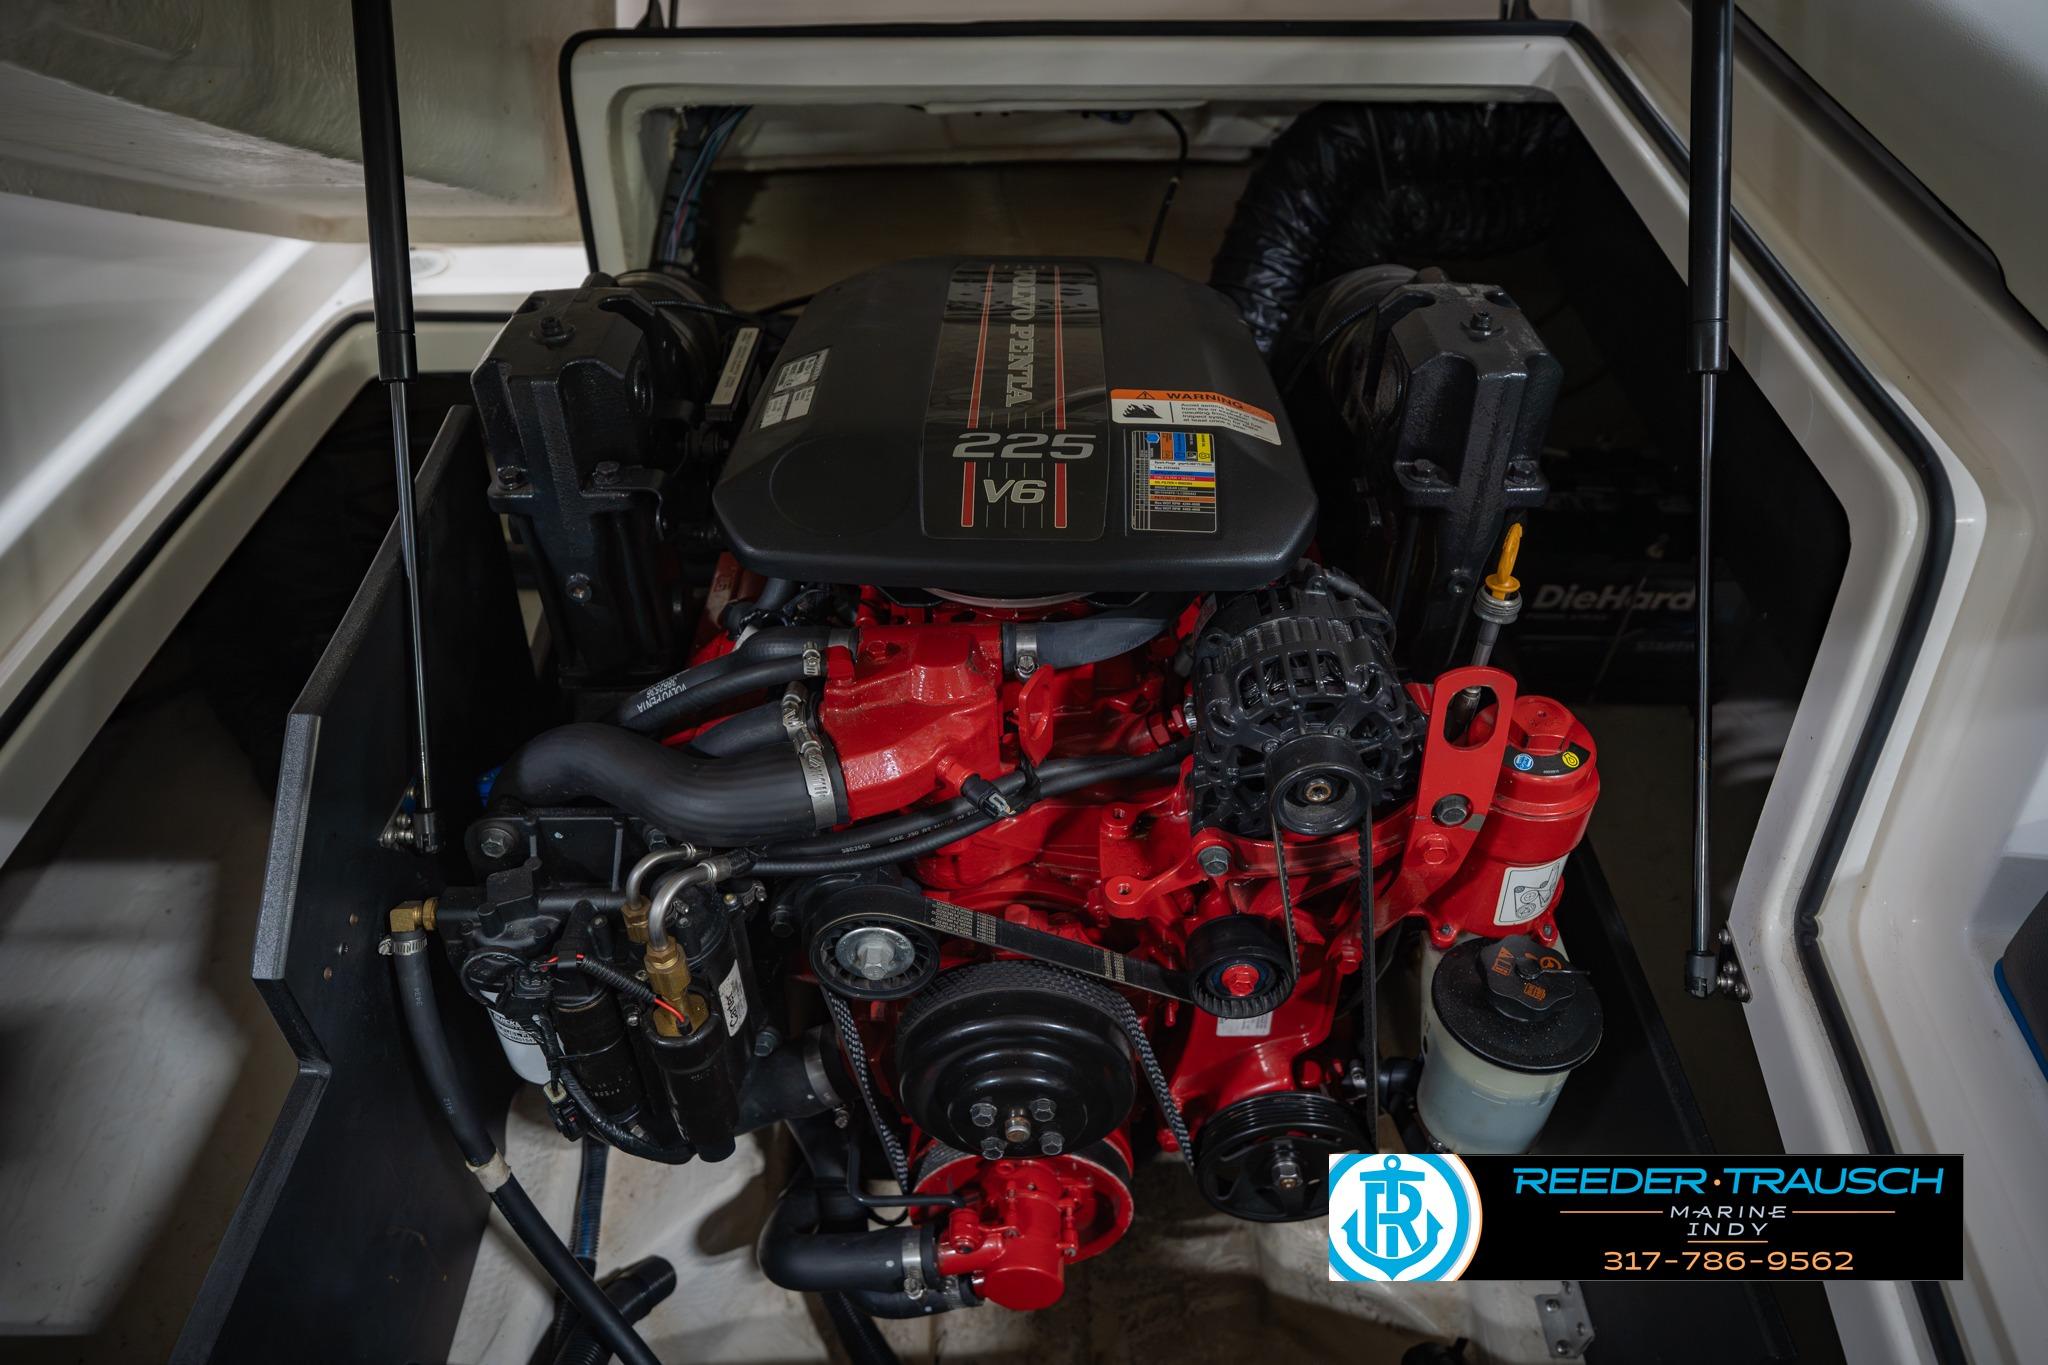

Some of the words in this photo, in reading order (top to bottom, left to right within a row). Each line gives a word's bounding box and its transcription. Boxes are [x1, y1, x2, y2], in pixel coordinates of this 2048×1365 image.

[1010, 269, 1036, 321] VOLVO
[1005, 323, 1035, 408] PENTA
[1166, 392, 1243, 410] WARNING
[952, 432, 1097, 460] 225
[983, 478, 1049, 504] V6
[1532, 584, 1696, 610] DieHard
[727, 991, 739, 1028] Carter
